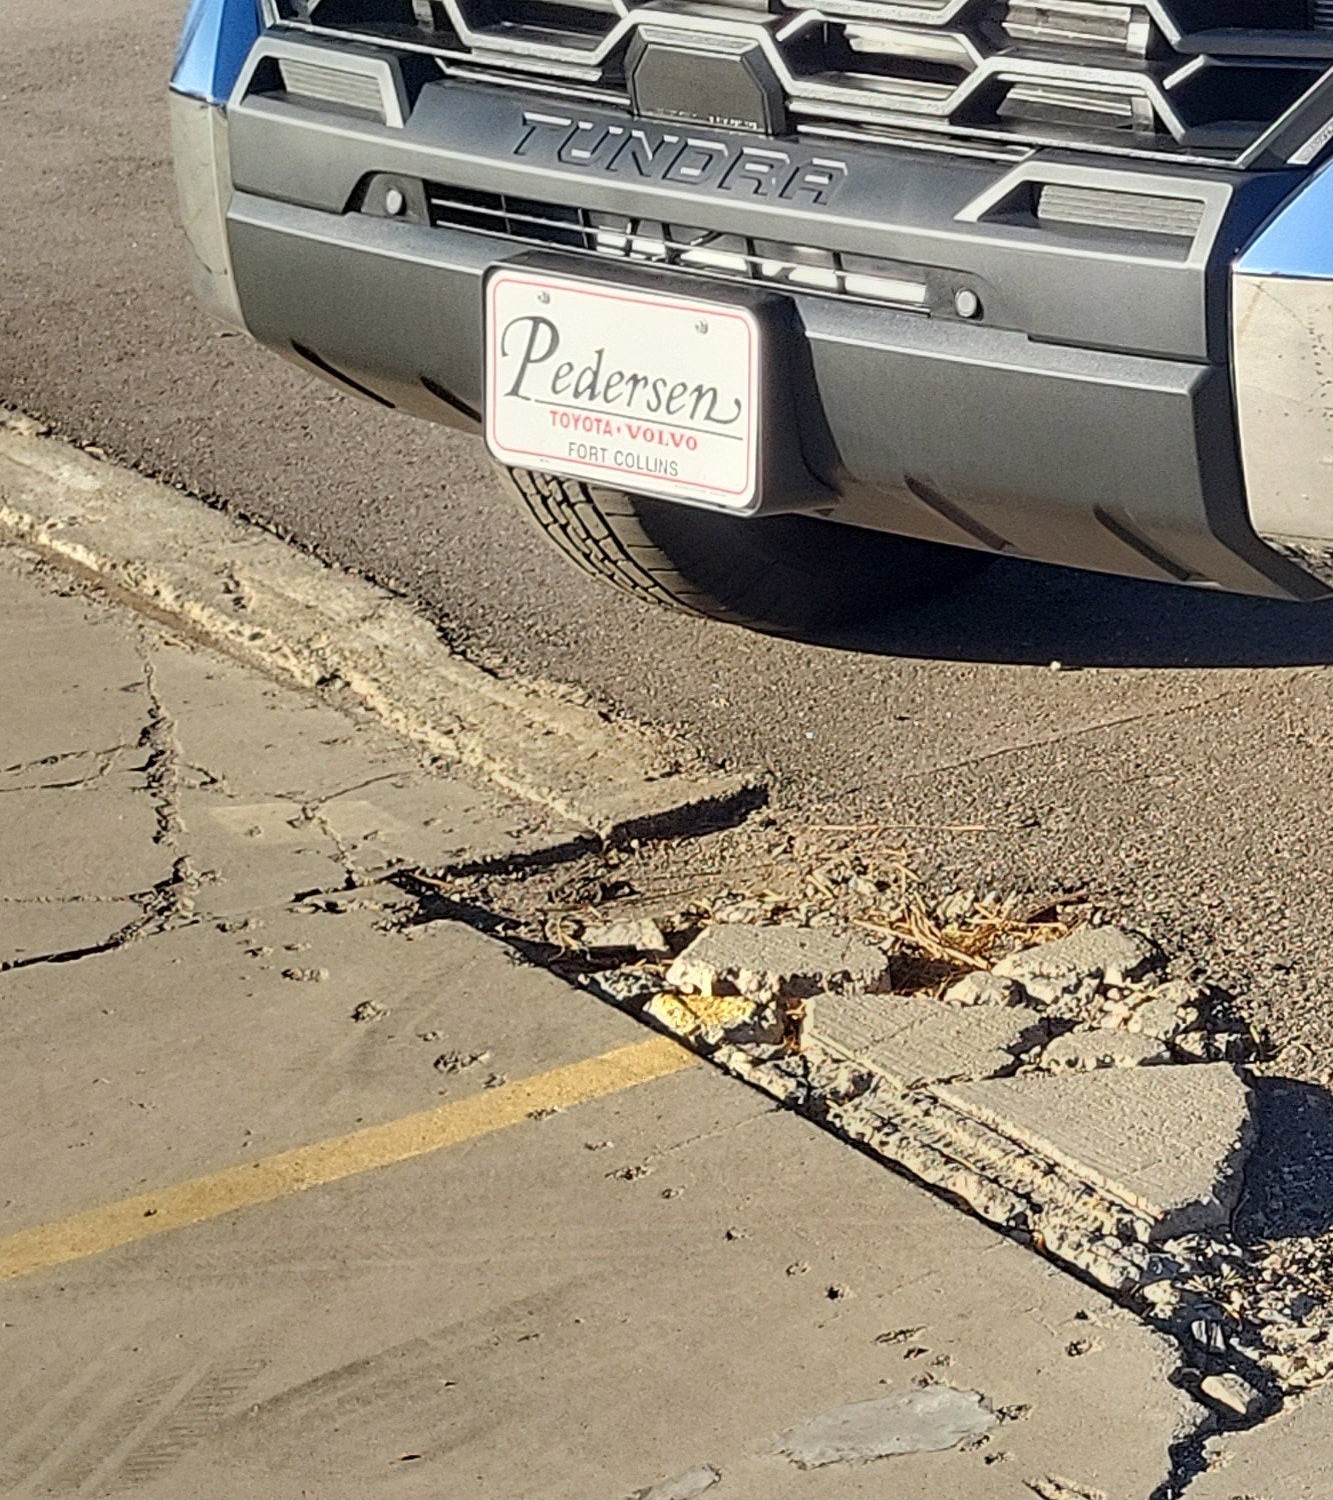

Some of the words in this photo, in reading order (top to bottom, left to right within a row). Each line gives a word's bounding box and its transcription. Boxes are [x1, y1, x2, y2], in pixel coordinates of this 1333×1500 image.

[513, 110, 849, 206] TUNDRA
[501, 315, 743, 425] Pedersen
[549, 410, 613, 438] TOYOTA
[624, 423, 699, 452] VOLVO
[567, 441, 608, 465] FORT
[613, 450, 680, 478] COLLINS
